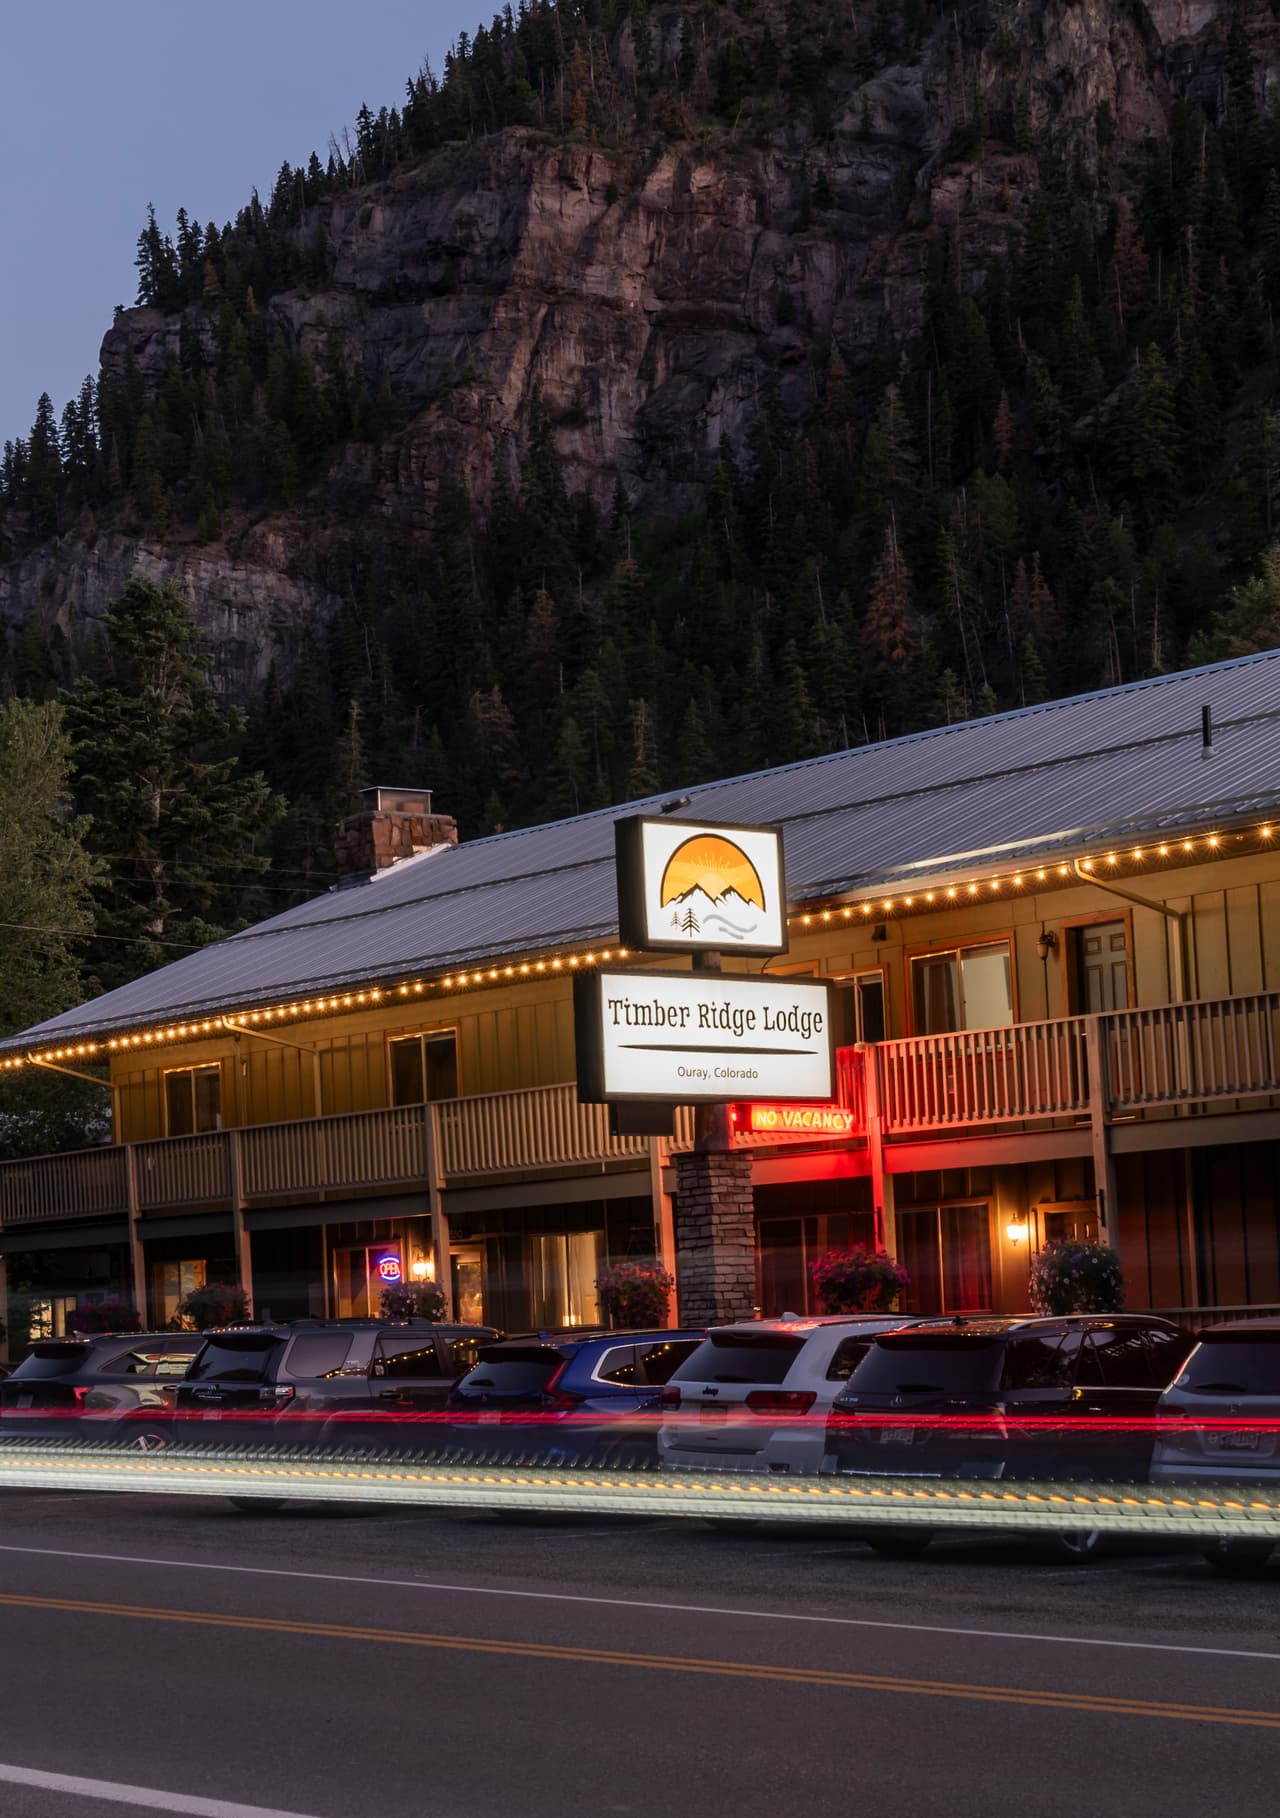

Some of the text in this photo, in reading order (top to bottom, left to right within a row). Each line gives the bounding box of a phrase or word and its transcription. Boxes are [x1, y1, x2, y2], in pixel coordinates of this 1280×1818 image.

[607, 997, 824, 1040] Timber Ridge Lodge
[677, 1065, 759, 1081] Ouray, Colorado
[756, 1110, 854, 1130] NO VACANCY
[380, 1262, 401, 1275] OPEN
[702, 1385, 719, 1398] Jeep
